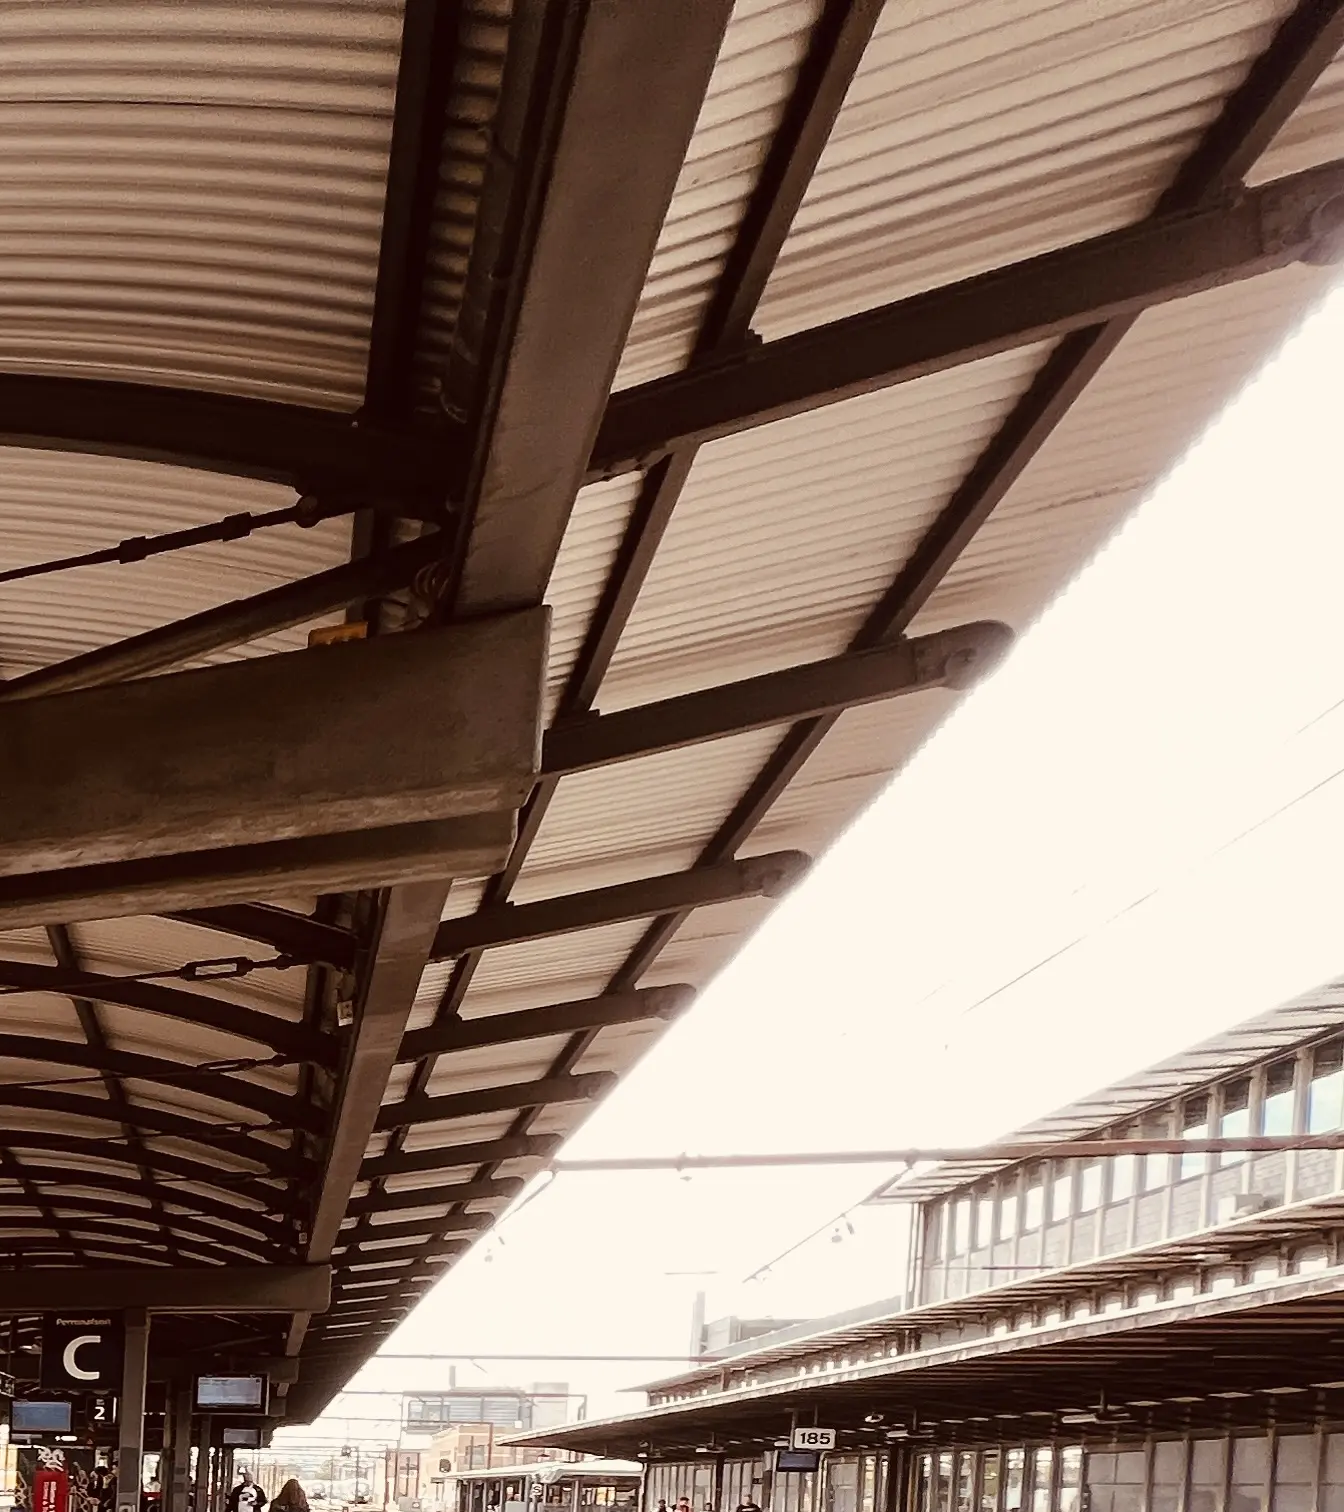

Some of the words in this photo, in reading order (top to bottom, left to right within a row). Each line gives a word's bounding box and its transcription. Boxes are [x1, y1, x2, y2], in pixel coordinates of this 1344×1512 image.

[62, 1335, 102, 1380] C
[93, 1406, 106, 1420] 2
[800, 1432, 831, 1444] 185
